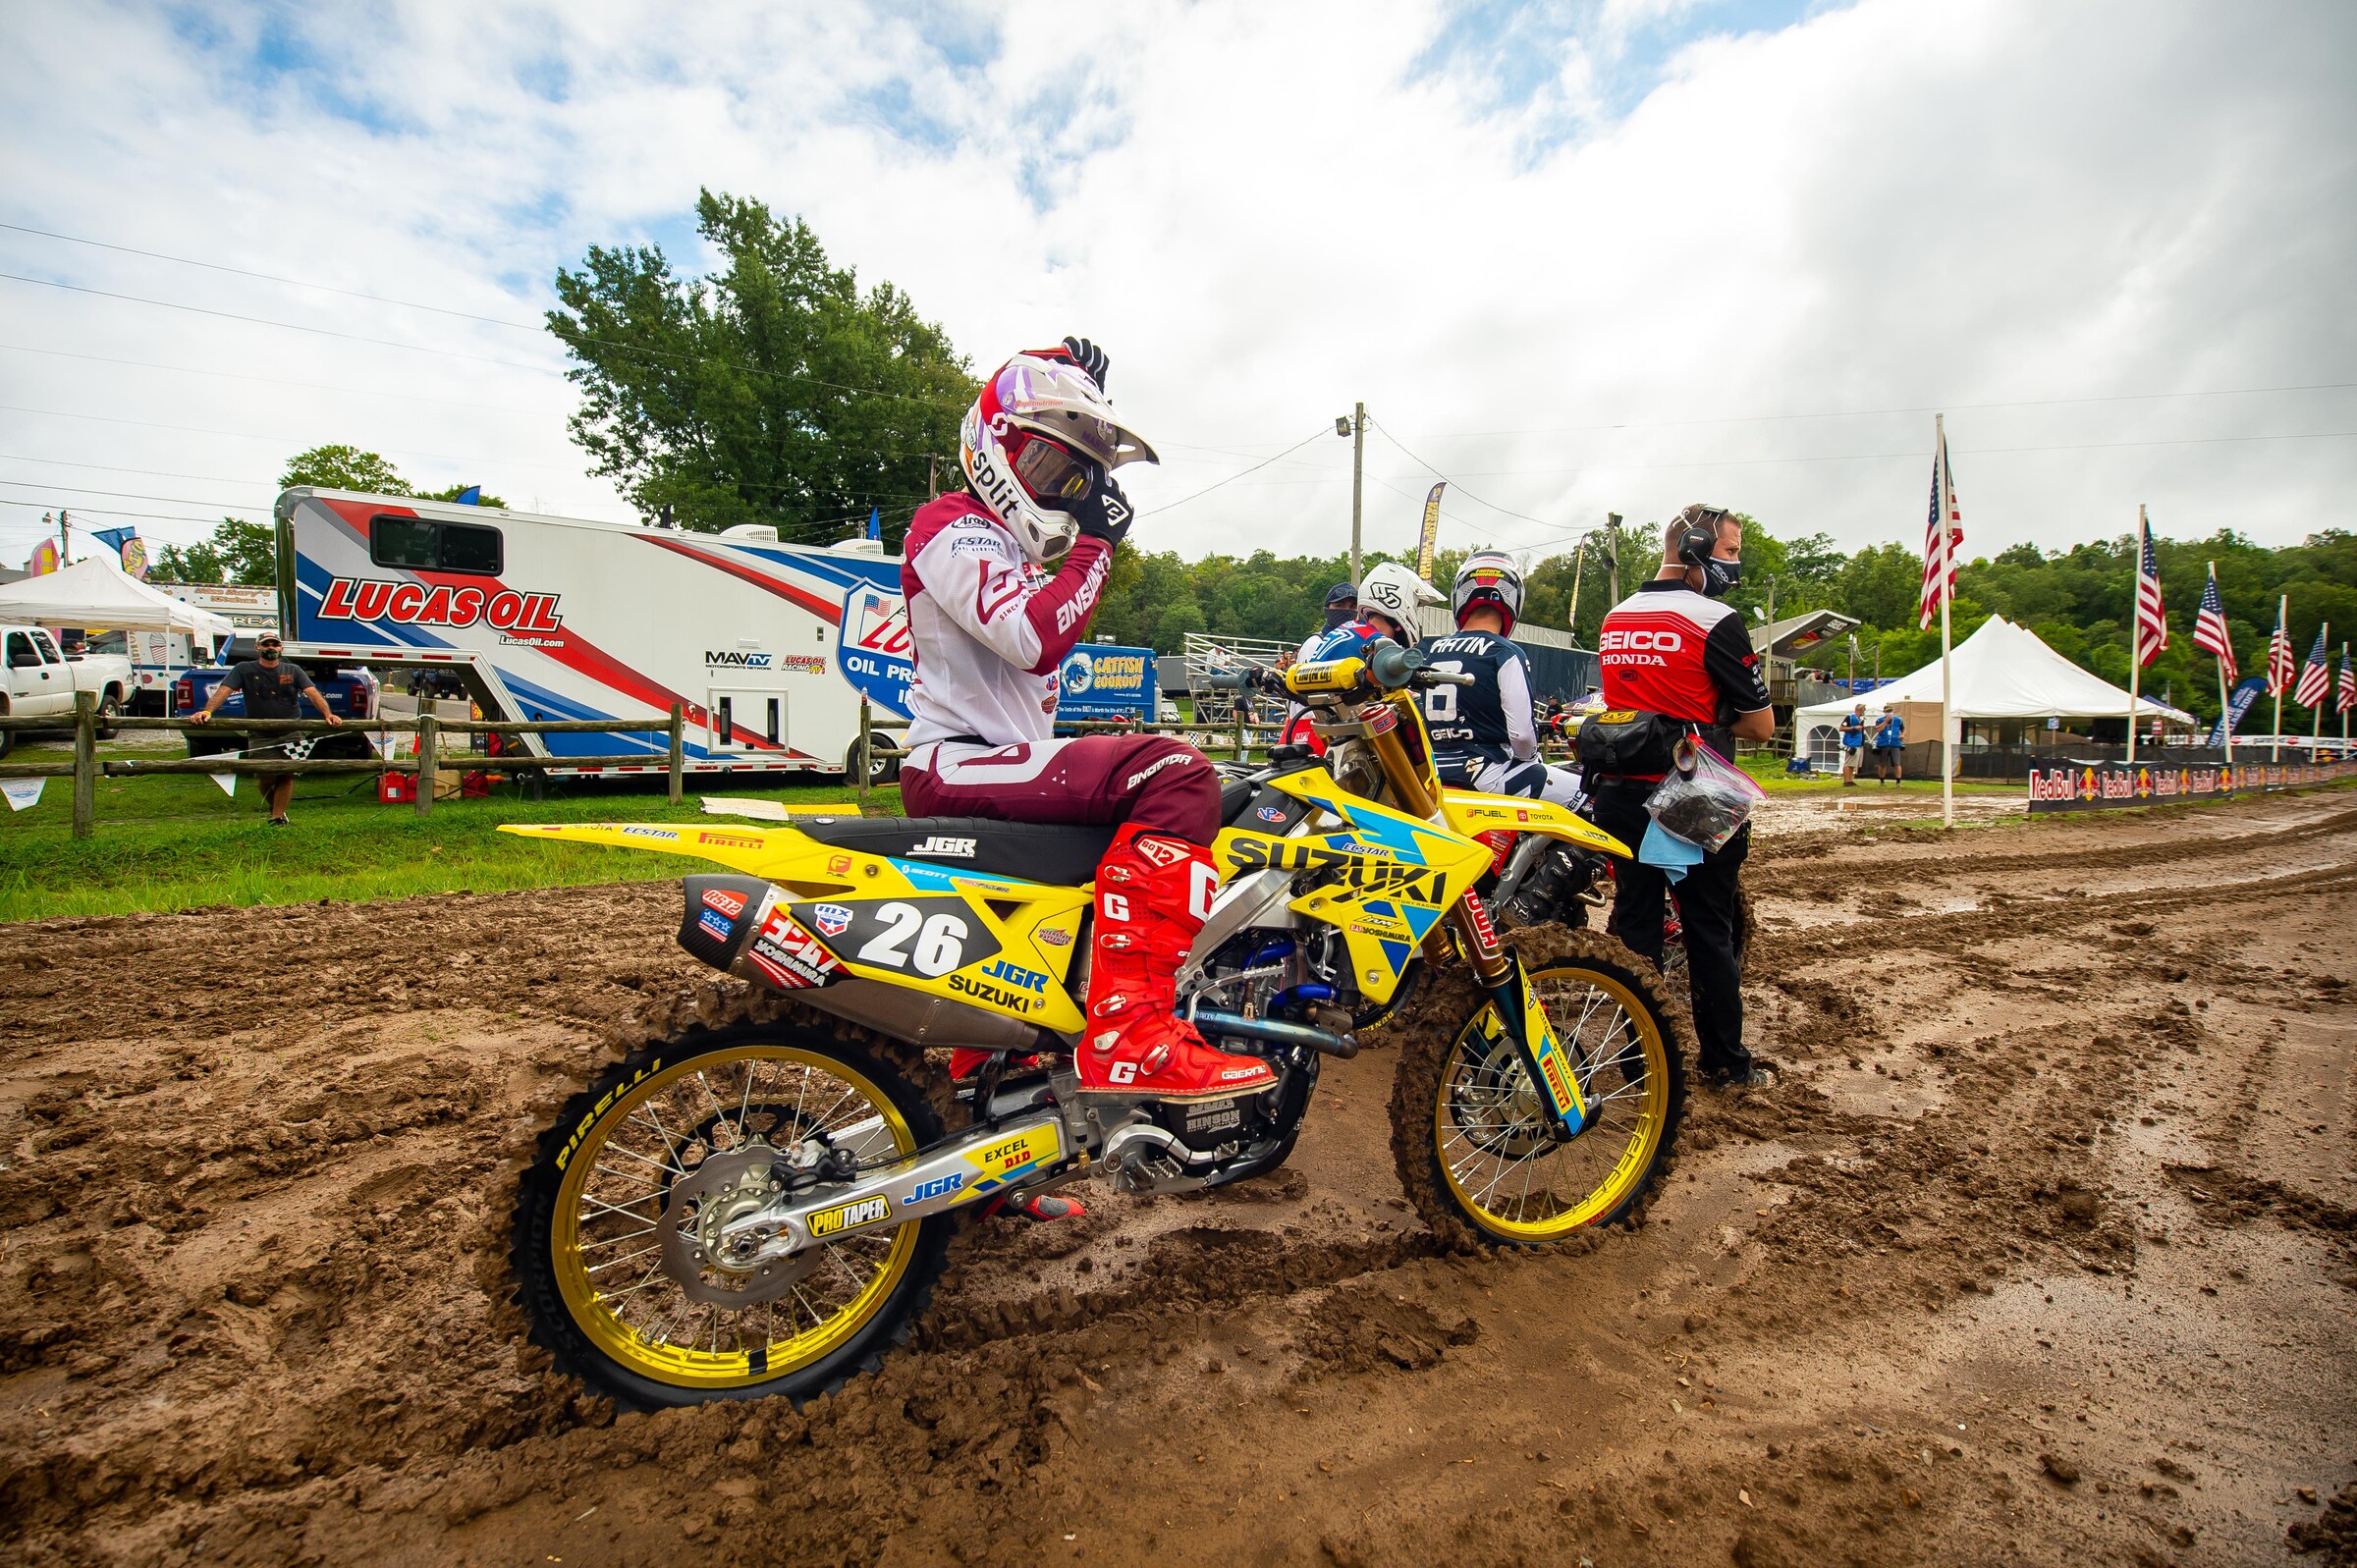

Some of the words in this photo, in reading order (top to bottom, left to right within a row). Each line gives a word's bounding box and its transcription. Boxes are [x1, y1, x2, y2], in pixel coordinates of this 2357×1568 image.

[1014, 400, 1064, 408] @splitnutrition
[972, 451, 1019, 520] split
[317, 576, 484, 628] LUCAS
[486, 590, 563, 631] OIL
[232, 616, 278, 626] REA
[499, 635, 565, 648] LucasOil.com
[1600, 630, 1681, 652] GEICO
[785, 655, 812, 665] LUCAS
[847, 656, 880, 676] OIL
[1093, 656, 1145, 675] CATFISH
[1602, 654, 1668, 667] HONDA
[1093, 675, 1144, 690] COOKOUT
[1376, 715, 1395, 730] GET
[1431, 728, 1473, 740] GEICO
[1258, 807, 1278, 821] VP
[623, 827, 678, 839] ECSTAR
[698, 833, 765, 849] PIRELLI
[913, 837, 977, 854] JGR
[1343, 842, 1390, 857] ECSTAR
[910, 867, 949, 879] SCOTT
[1228, 837, 1449, 905] SUZUKI
[1103, 892, 1129, 922] G
[856, 901, 968, 977] 26
[1362, 927, 1411, 943] YOSHIMURA
[754, 940, 826, 988] YOSHIMURA
[982, 960, 1049, 994] JGR
[948, 974, 1029, 1013] SUZUKI
[1109, 1061, 1138, 1085] G
[1543, 1056, 1570, 1109] PIRELLI
[555, 1057, 662, 1171] PIRELLI
[1186, 1109, 1239, 1130] HINSON
[984, 1138, 1028, 1163] EXCEL
[903, 1172, 963, 1206] JGR
[814, 1198, 886, 1234] PROTAPER
